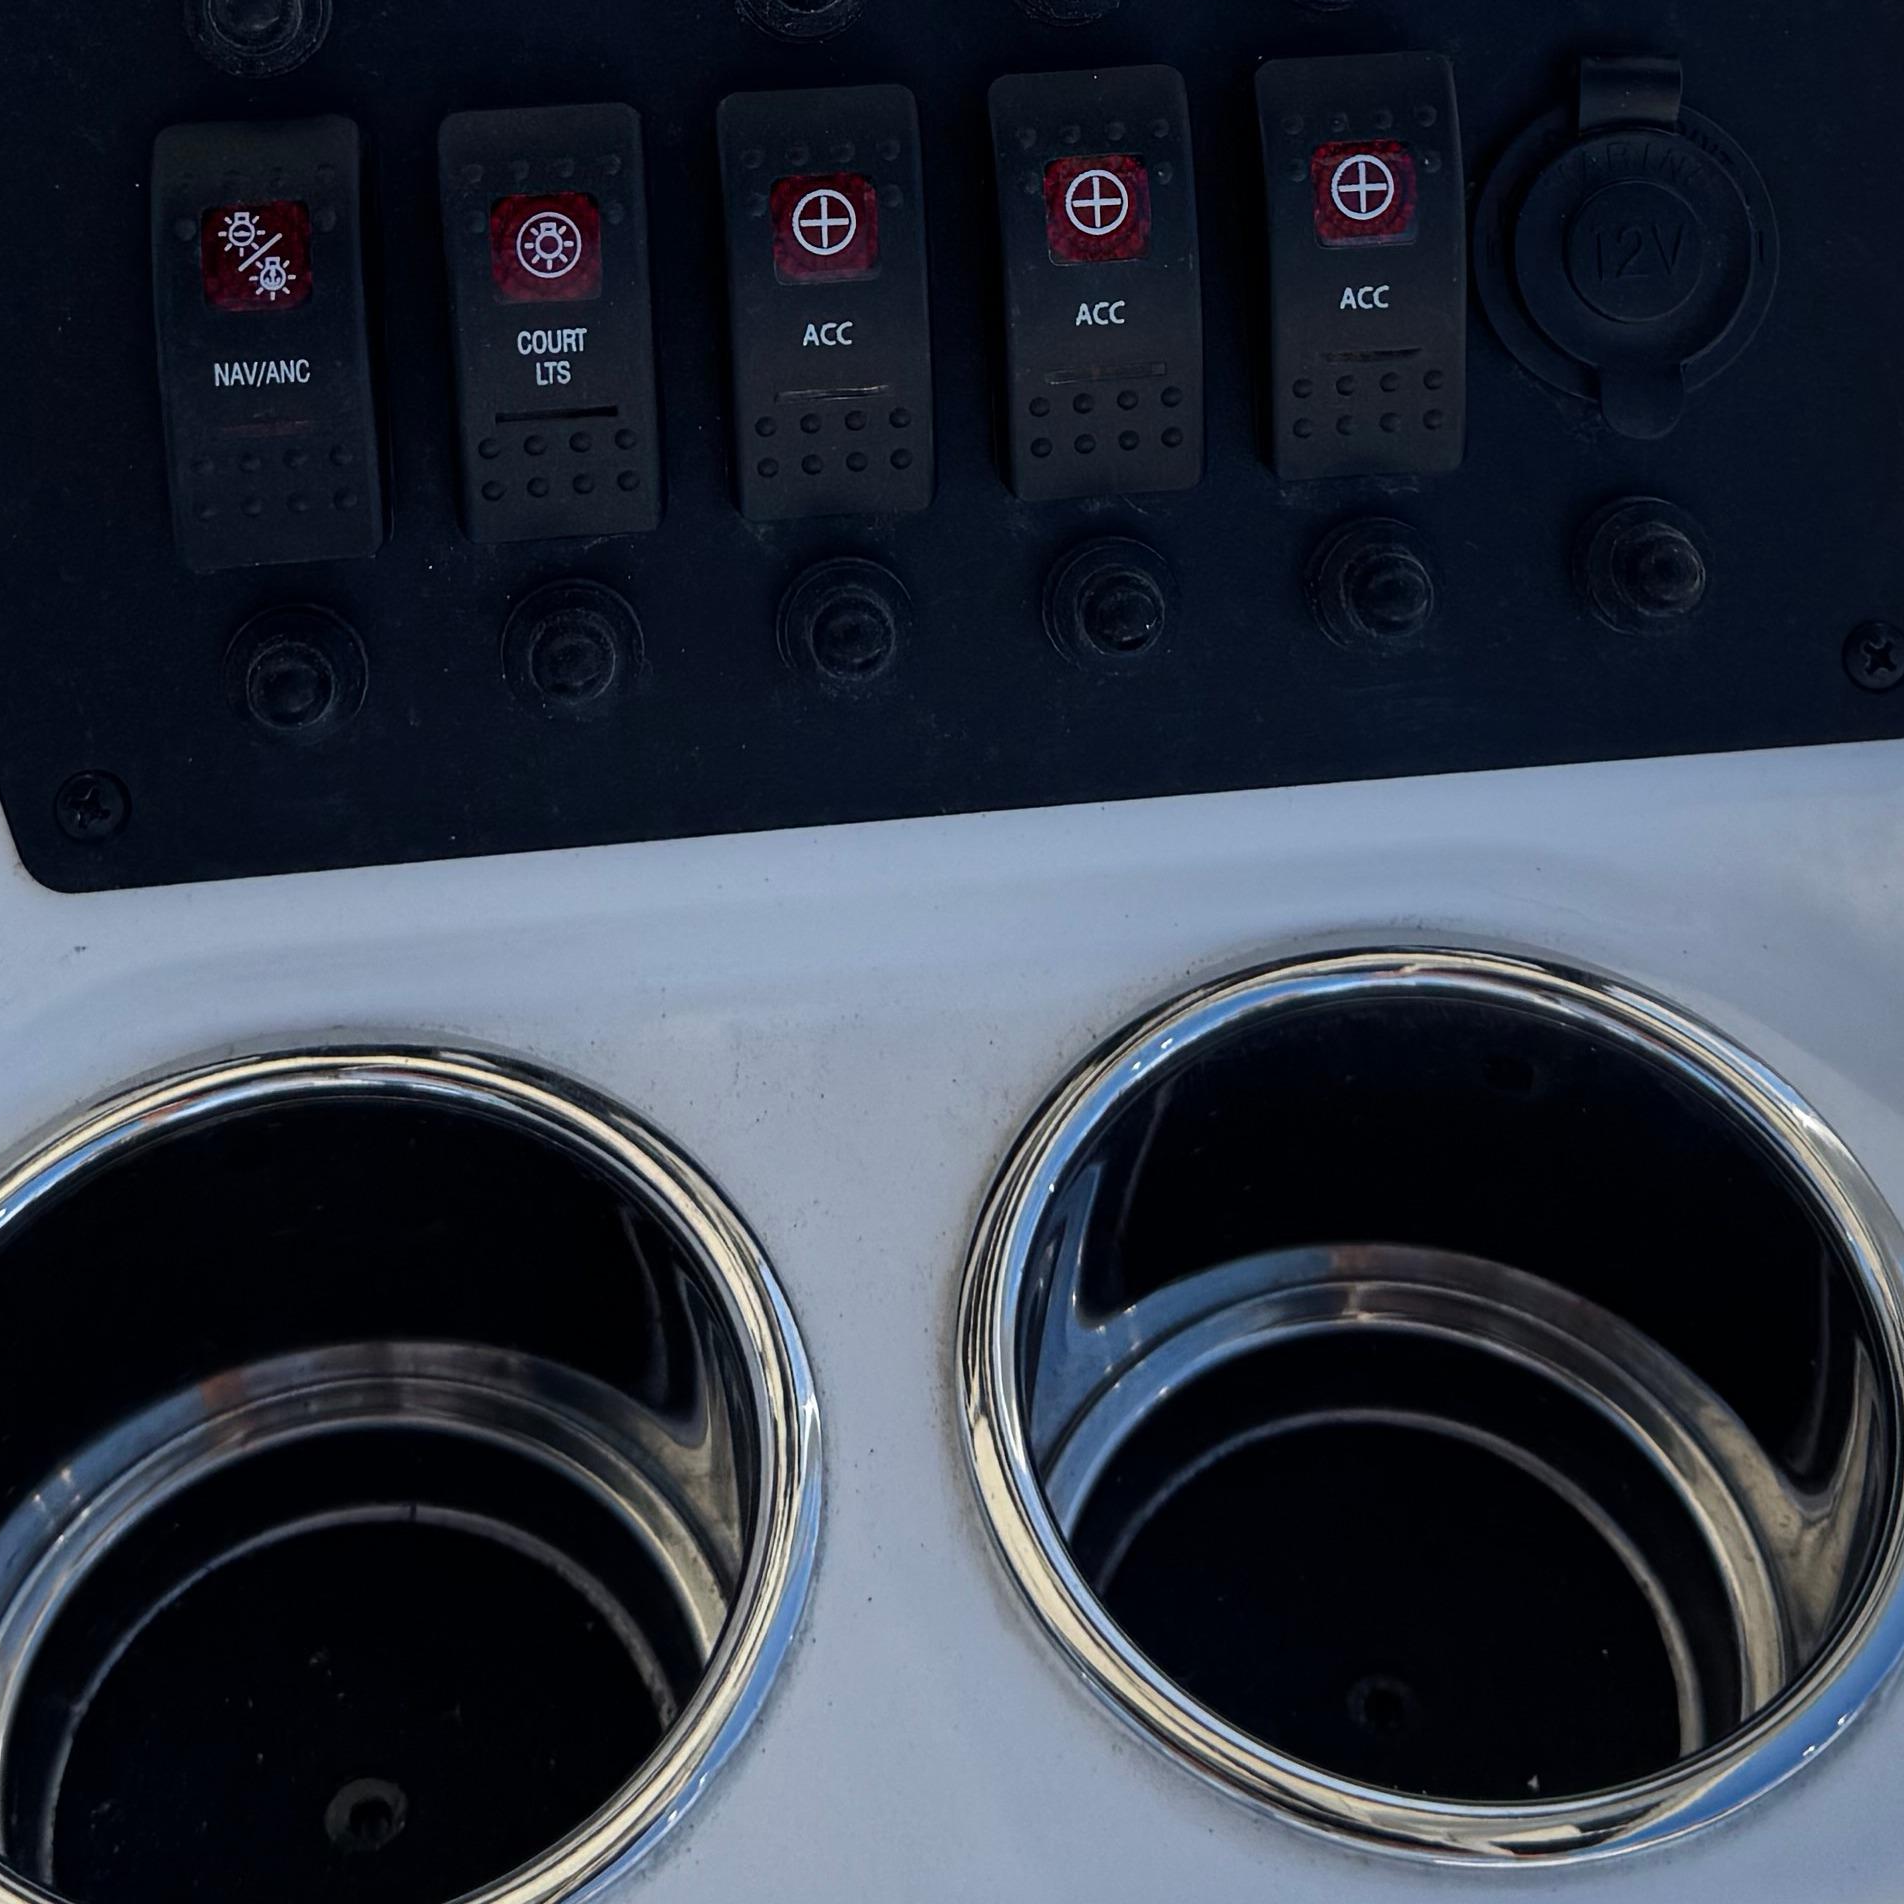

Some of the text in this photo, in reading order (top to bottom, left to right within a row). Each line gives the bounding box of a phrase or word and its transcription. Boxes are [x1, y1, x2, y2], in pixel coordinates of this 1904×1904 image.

[1591, 222, 1686, 282] 12V
[1339, 284, 1390, 310] ACC
[1075, 300, 1126, 326] ACC
[517, 327, 588, 356] COURT
[802, 320, 853, 347] ACC
[214, 358, 311, 388] NAV/ANC
[535, 360, 572, 386] LTS
